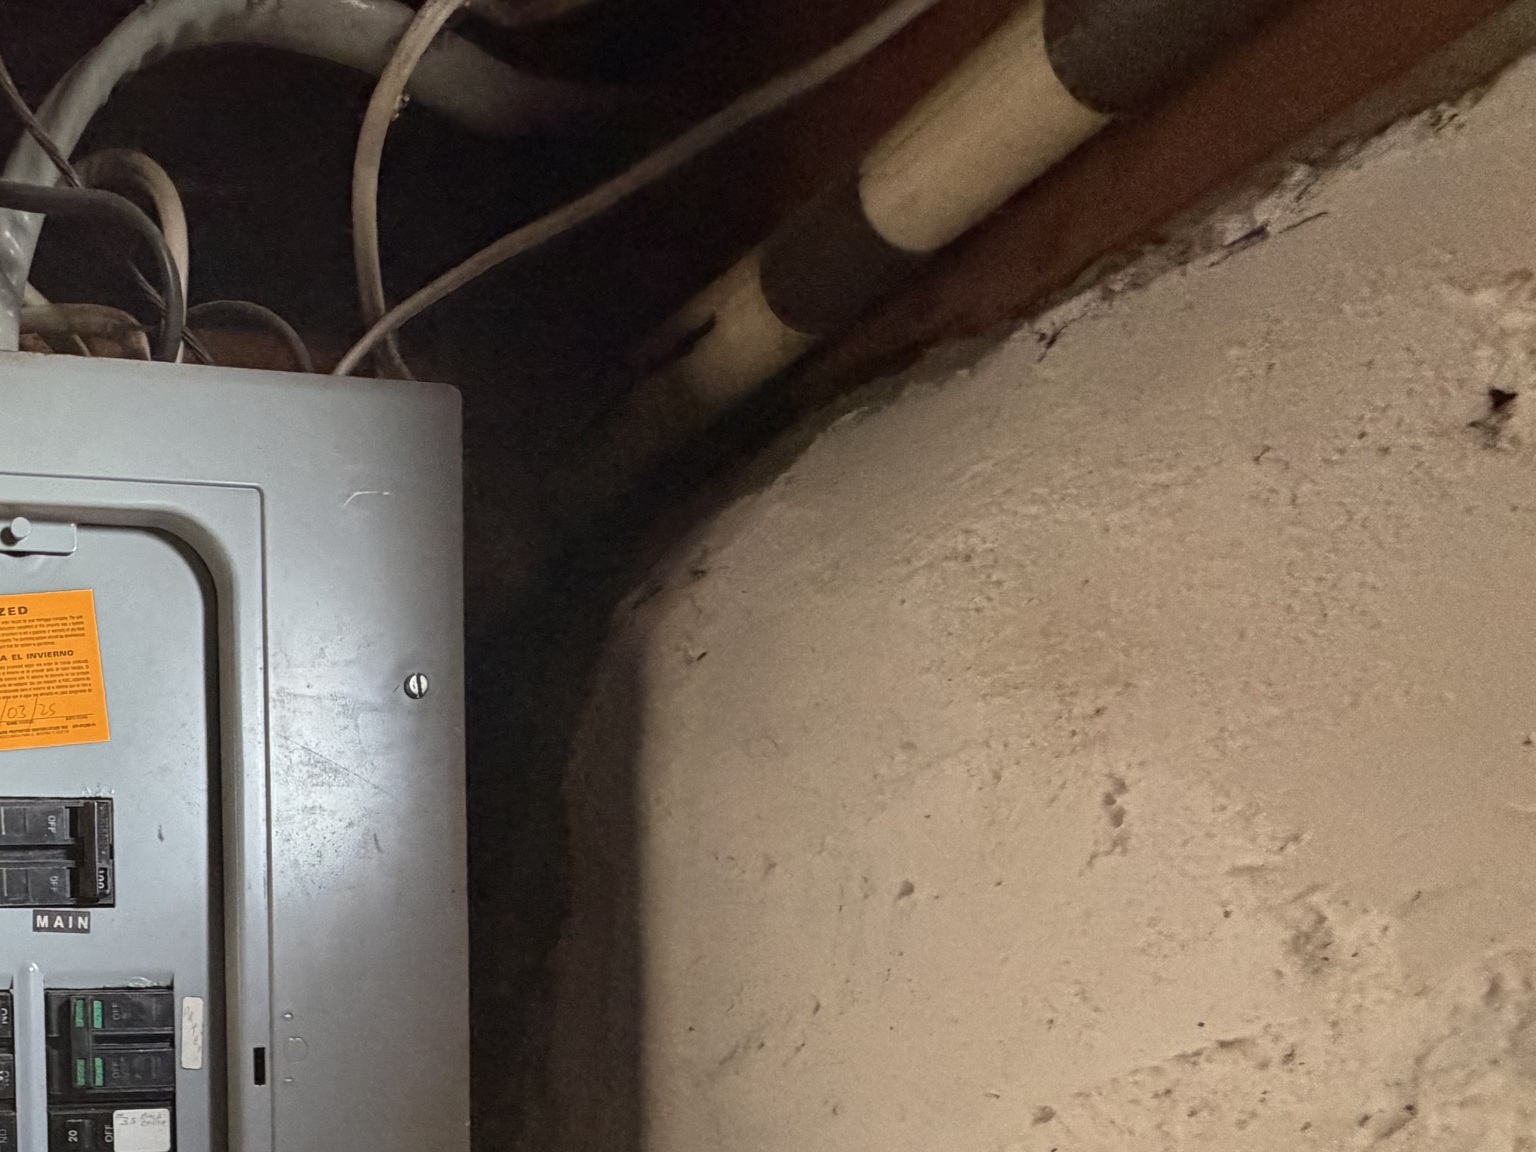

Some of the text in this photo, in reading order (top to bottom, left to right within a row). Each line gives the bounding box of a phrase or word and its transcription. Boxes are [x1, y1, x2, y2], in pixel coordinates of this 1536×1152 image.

[12, 652, 24, 662] EL
[26, 650, 75, 660] INVIERNO
[48, 814, 56, 834] OFF
[50, 876, 58, 892] OFF
[36, 915, 88, 929] MAIN
[0, 1128, 8, 1144] ON
[68, 1130, 78, 1142] 20
[104, 1124, 114, 1142] OFF
